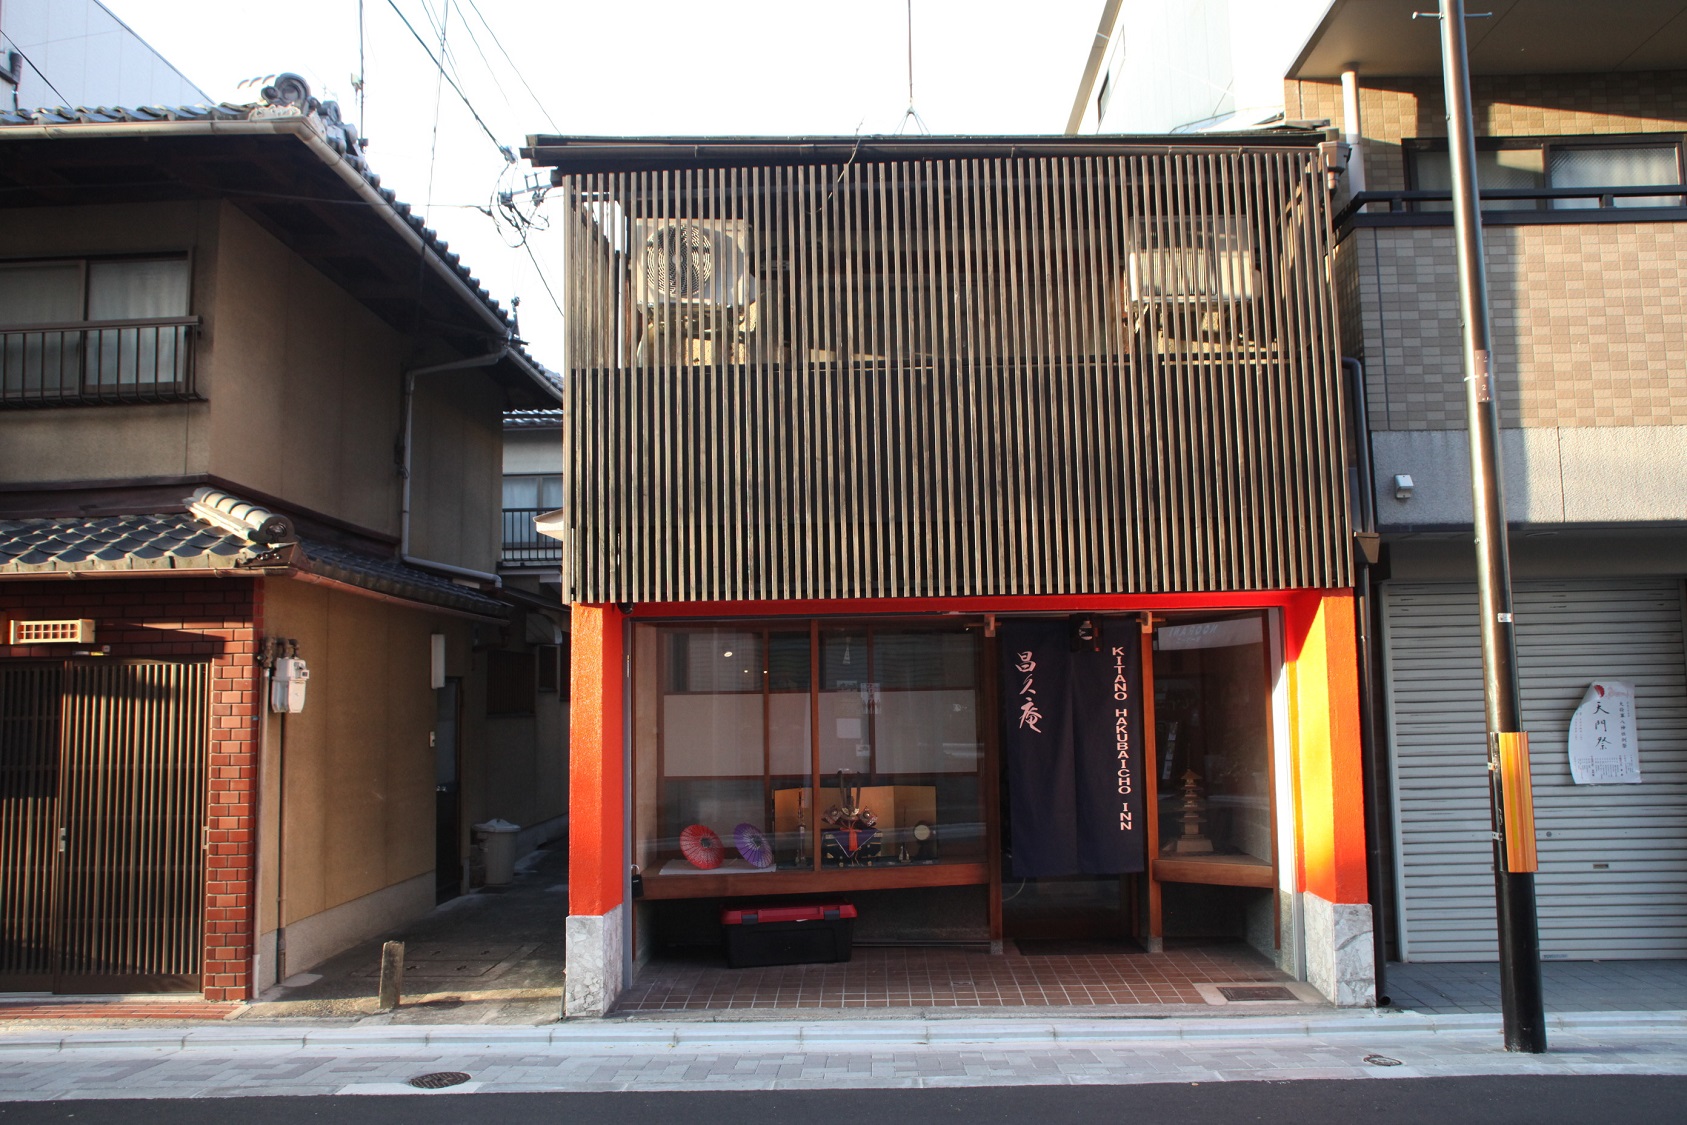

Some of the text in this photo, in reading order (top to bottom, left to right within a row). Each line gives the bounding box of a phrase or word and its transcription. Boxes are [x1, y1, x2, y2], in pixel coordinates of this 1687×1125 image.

[1015, 650, 1042, 734] 昌久庵
[1593, 701, 1612, 750] 天門祭
[1112, 646, 1132, 831] KITANO HAKUBAICHO INN
